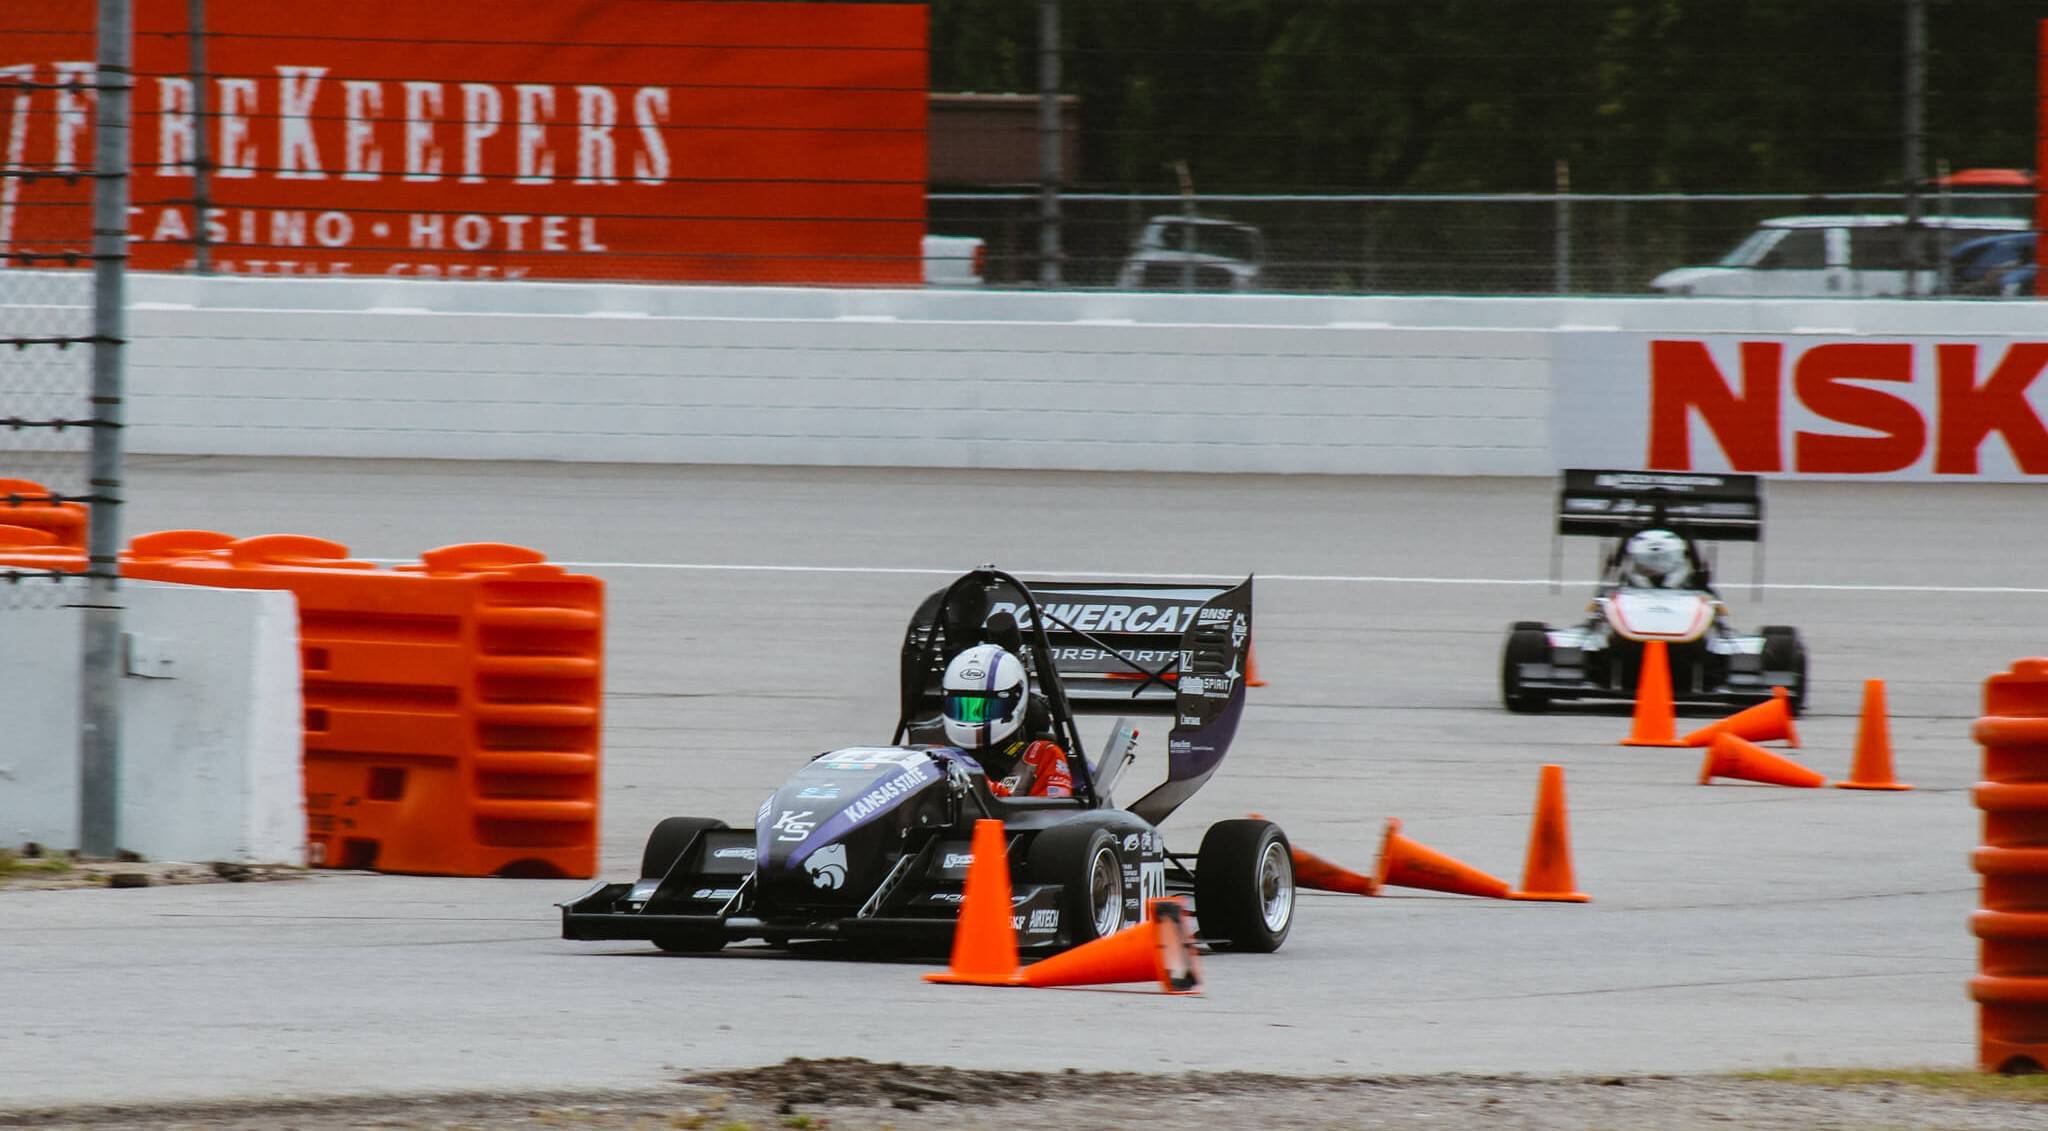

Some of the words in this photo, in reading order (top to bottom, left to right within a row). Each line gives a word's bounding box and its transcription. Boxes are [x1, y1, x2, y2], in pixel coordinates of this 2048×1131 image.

[52, 61, 671, 186] FREKEEPERS
[410, 214, 608, 253] HOTEL
[1646, 340, 2048, 475] NSK
[982, 602, 1200, 633] POWERCAT
[1199, 607, 1235, 620] BNSF
[1203, 678, 1230, 691] SPIRIT
[843, 780, 899, 823] KANSAS
[892, 766, 929, 794] STATE
